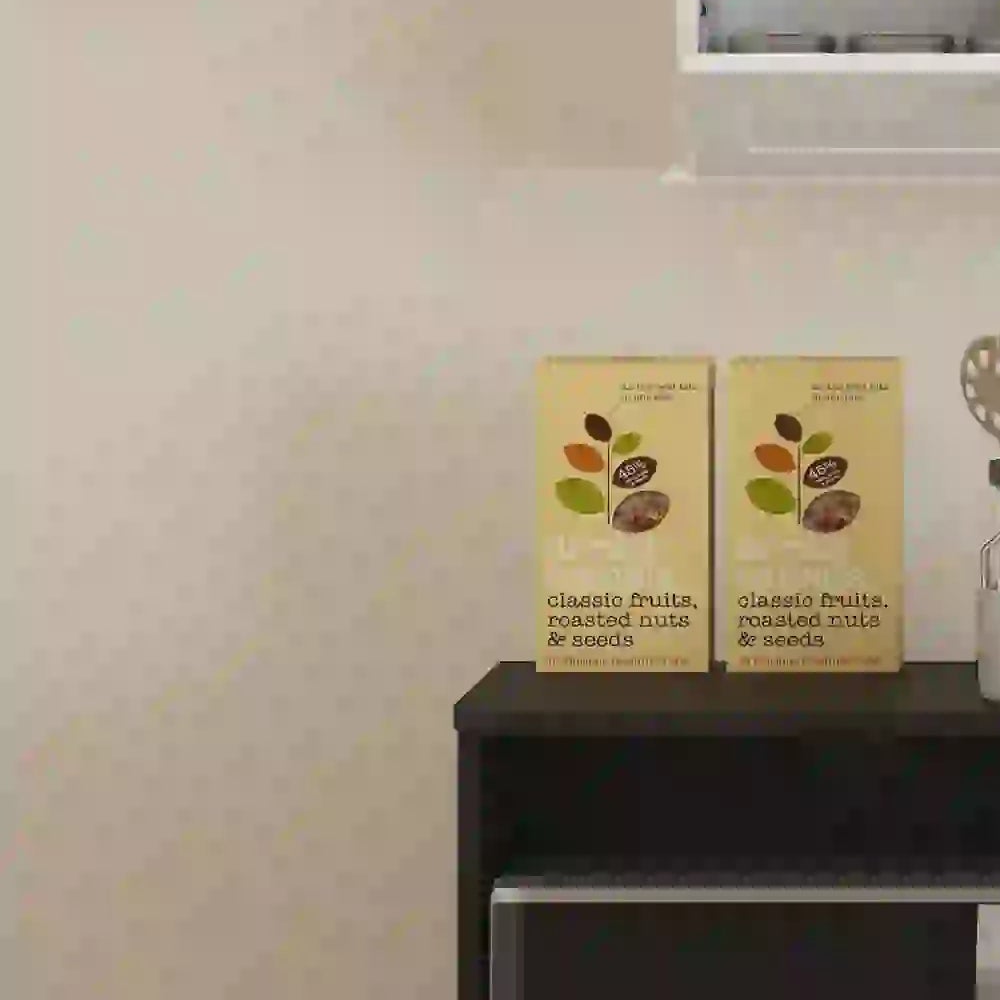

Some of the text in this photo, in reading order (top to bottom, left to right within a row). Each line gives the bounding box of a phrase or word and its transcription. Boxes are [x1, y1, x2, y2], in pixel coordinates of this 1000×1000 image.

[547, 592, 698, 609] classic fruits,
[737, 592, 813, 609] classic
[547, 611, 690, 628] roasted nuts
[737, 611, 881, 628] roasted nuts
[547, 631, 634, 648] & seeds
[737, 631, 825, 648] & seeds
